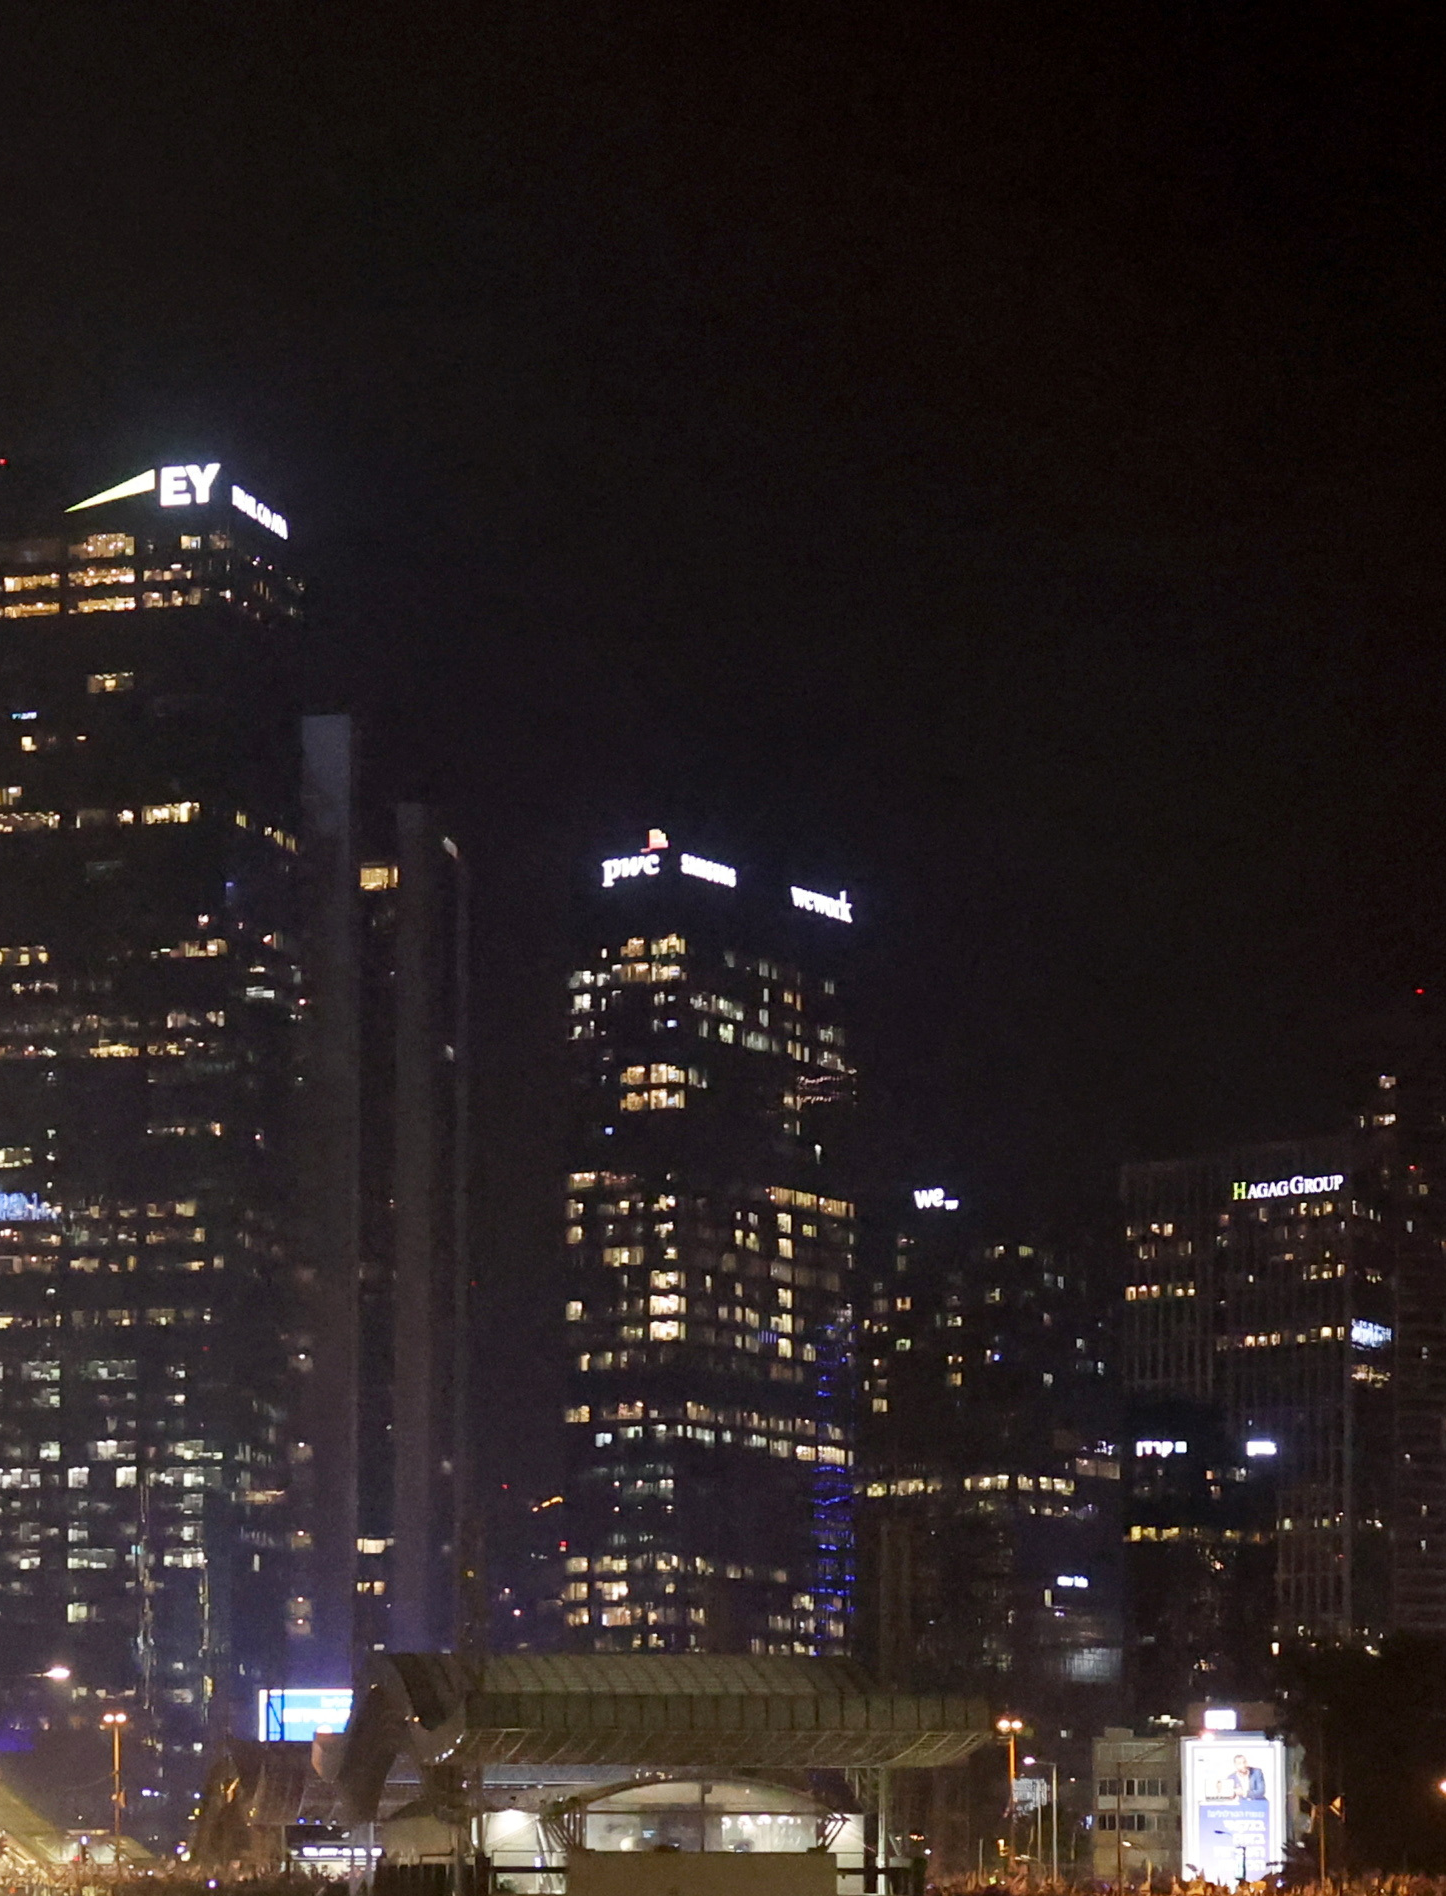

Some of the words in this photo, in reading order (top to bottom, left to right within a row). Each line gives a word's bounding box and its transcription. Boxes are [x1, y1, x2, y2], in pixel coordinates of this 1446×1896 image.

[160, 463, 221, 506] EY
[602, 854, 660, 887] pwc
[1232, 1180, 1289, 1200] HAGAG
[1289, 1174, 1345, 1195] GROUP
